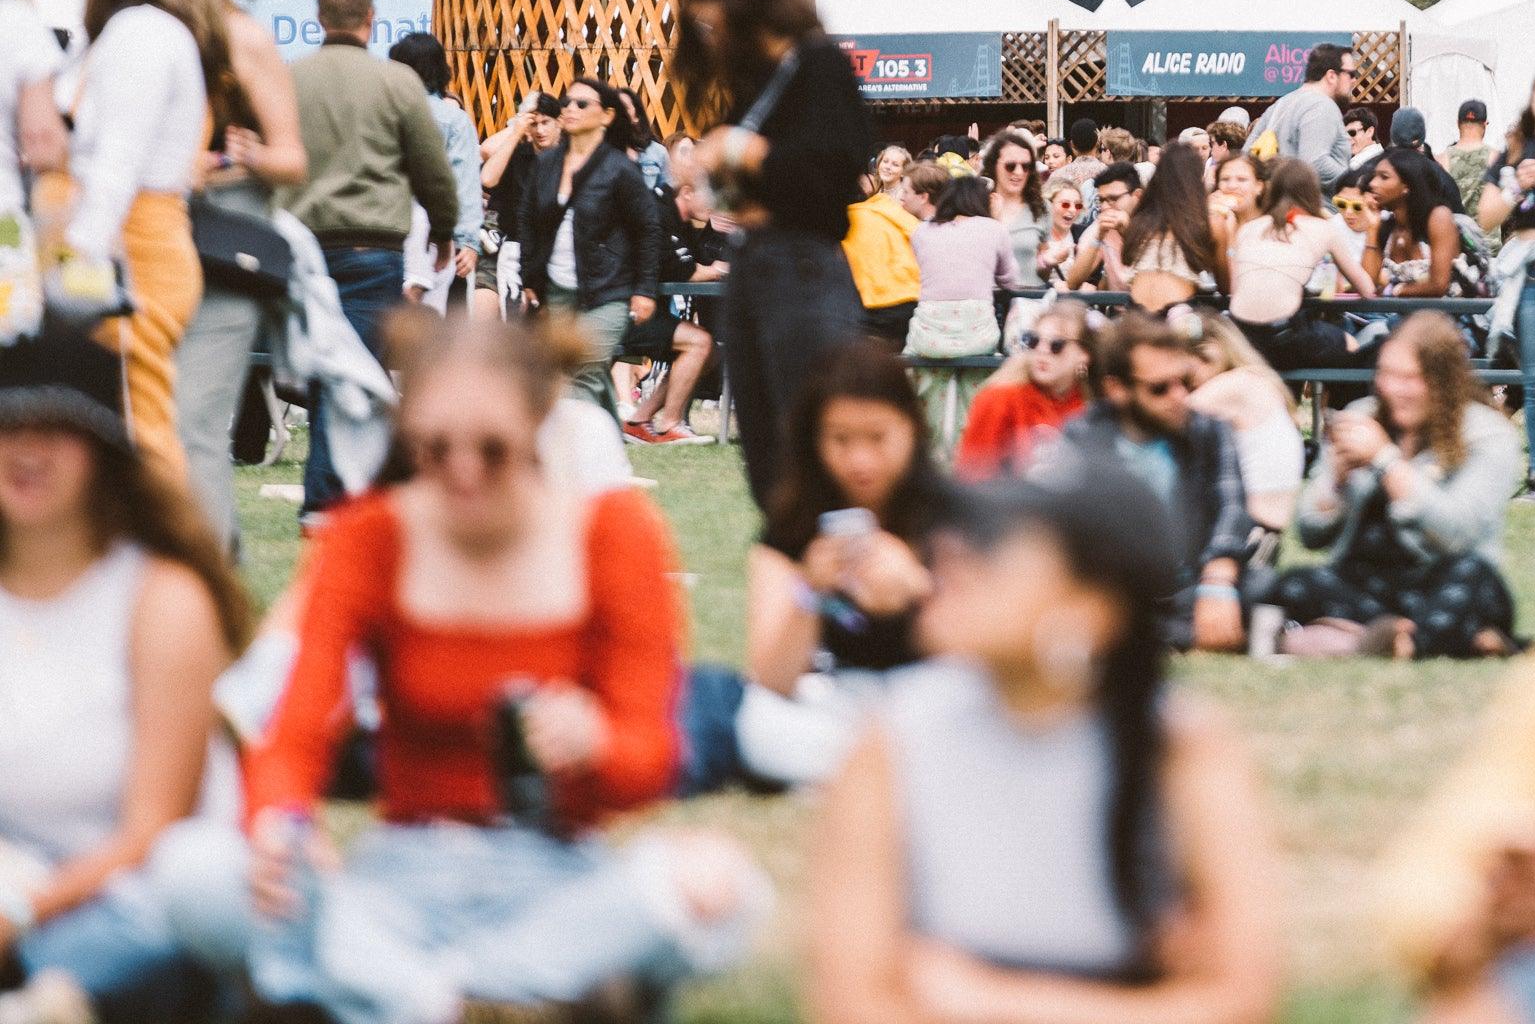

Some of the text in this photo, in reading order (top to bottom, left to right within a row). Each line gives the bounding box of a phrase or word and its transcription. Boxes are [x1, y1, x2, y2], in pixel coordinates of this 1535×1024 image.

[1142, 52, 1246, 74] ALICE RADIO
[883, 83, 928, 92] ALTERNATIVE
